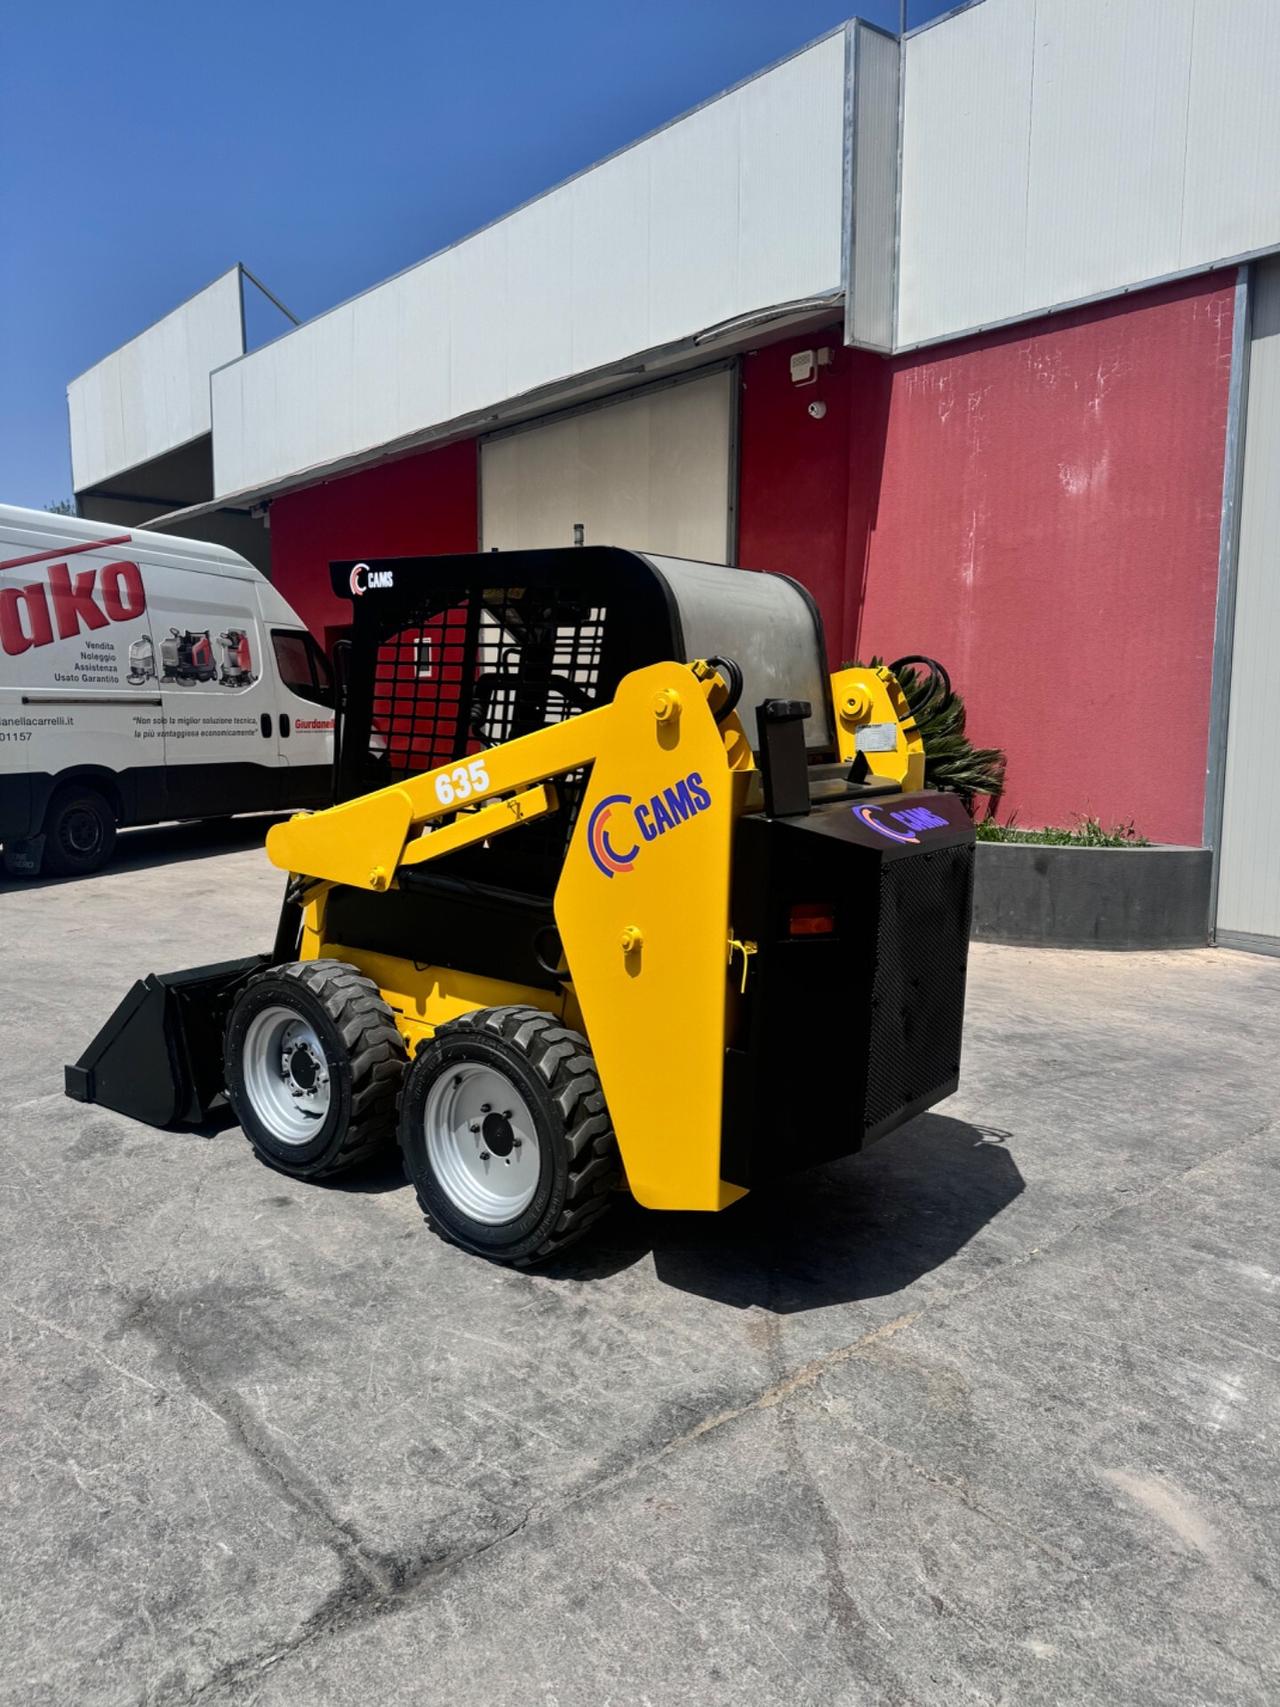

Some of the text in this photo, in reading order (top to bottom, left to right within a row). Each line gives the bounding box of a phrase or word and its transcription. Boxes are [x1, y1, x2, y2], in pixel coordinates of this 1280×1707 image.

[367, 571, 394, 589] CAMS
[0, 561, 146, 656] ako
[85, 641, 115, 650] Vendita
[80, 652, 117, 662] Noleggio
[74, 663, 118, 672] Assistenza
[54, 673, 119, 683] Usato Garantito
[152, 716, 168, 724] solo
[169, 716, 176, 724] la
[177, 716, 201, 726] miglior
[202, 716, 233, 724] soluzione
[0, 731, 32, 742] 01157
[134, 730, 142, 738] la
[434, 759, 490, 805] 635
[633, 772, 712, 842] CAMS
[889, 806, 951, 832] CAMS
